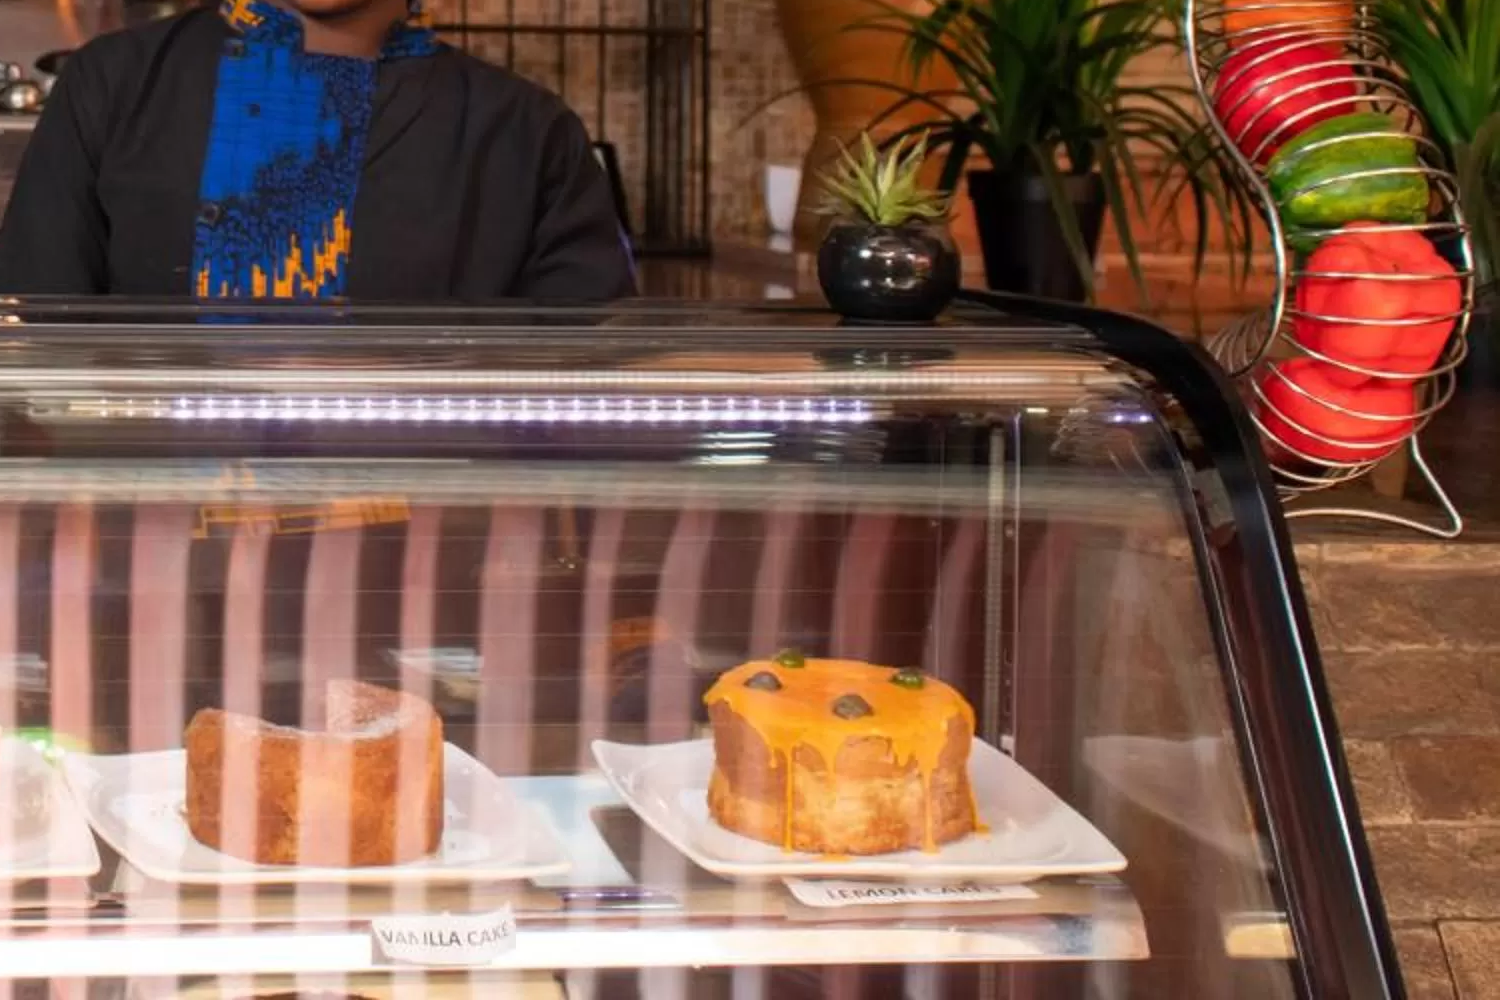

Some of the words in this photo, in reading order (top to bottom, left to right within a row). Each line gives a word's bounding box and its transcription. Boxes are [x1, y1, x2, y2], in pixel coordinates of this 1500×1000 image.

[825, 885, 918, 900] LEMON
[380, 929, 462, 947] VANILLA
[467, 919, 509, 946] CAKE
